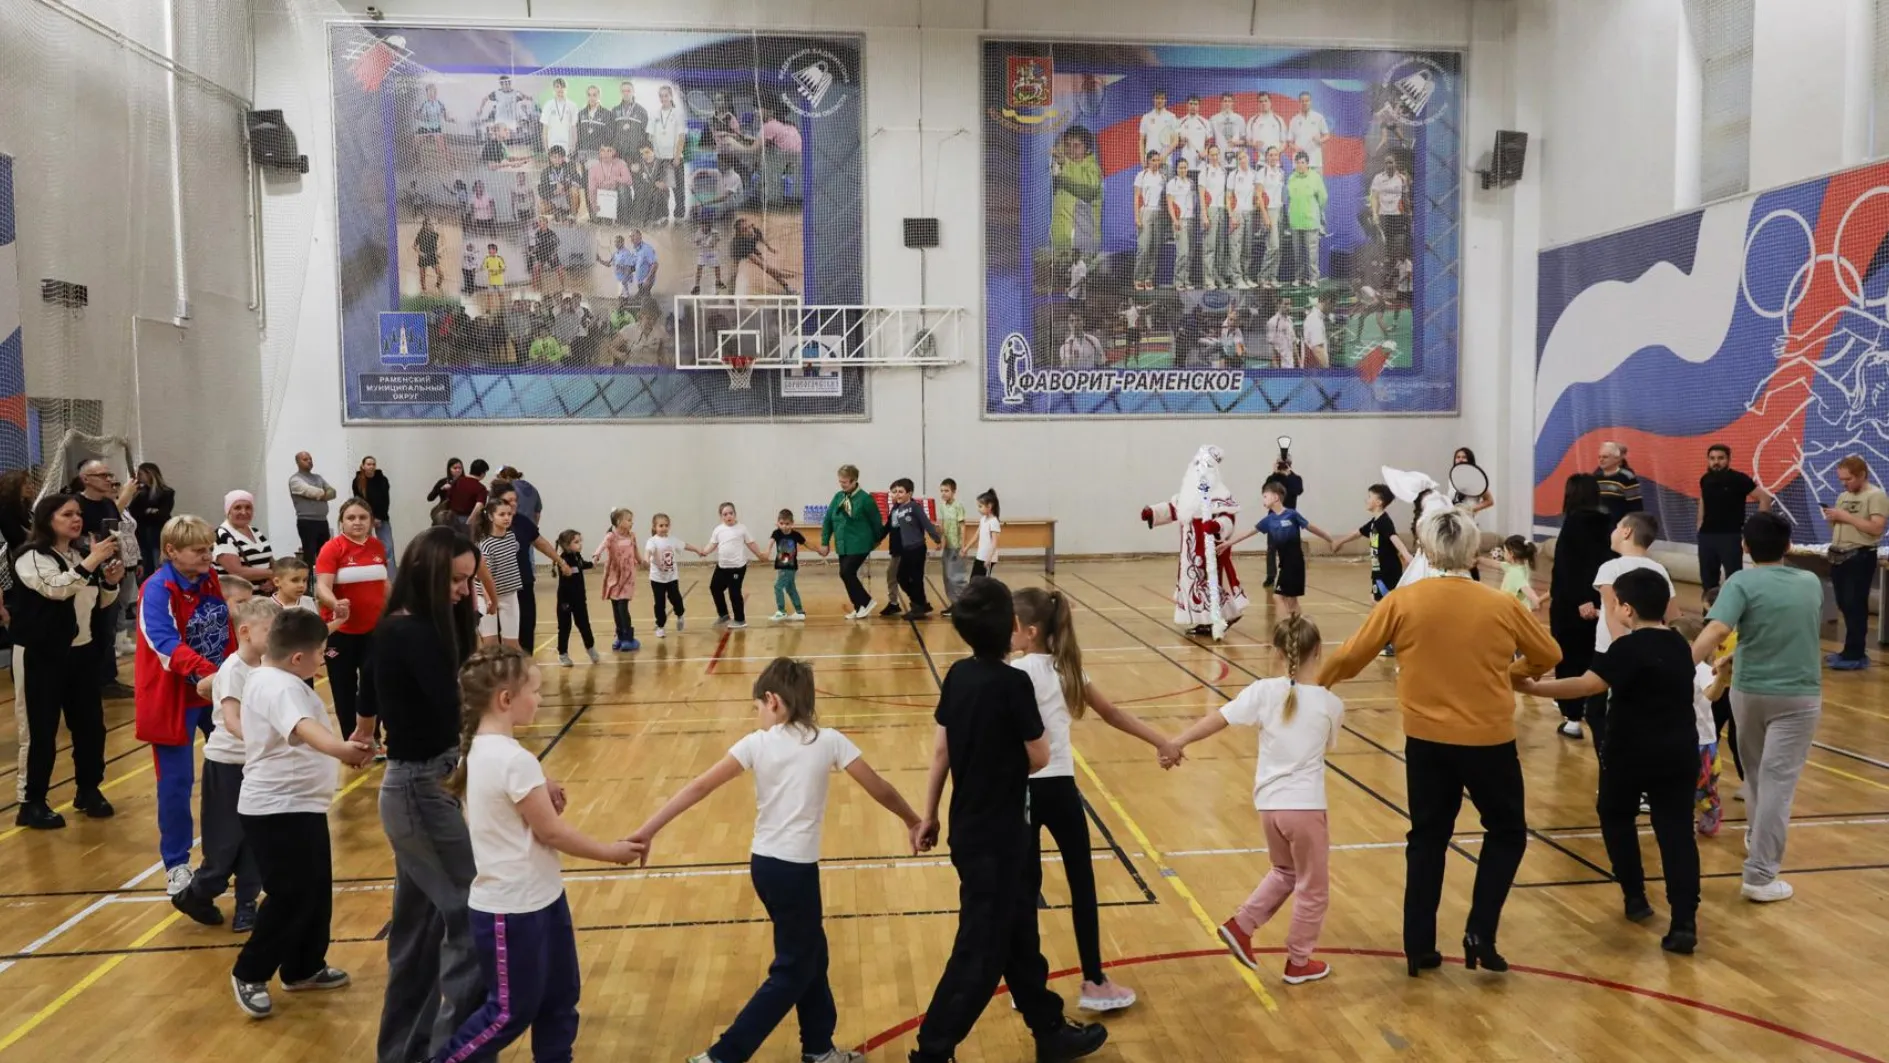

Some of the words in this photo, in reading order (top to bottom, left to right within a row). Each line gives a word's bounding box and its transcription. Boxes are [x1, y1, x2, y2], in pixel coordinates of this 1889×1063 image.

[379, 375, 431, 383] РАМЕНСКИЙ
[1018, 371, 1244, 391] ФАВОРИТ-РАМЕНСКОЕ
[366, 384, 445, 392] МУНИЦИПАЛЬНЫЙ
